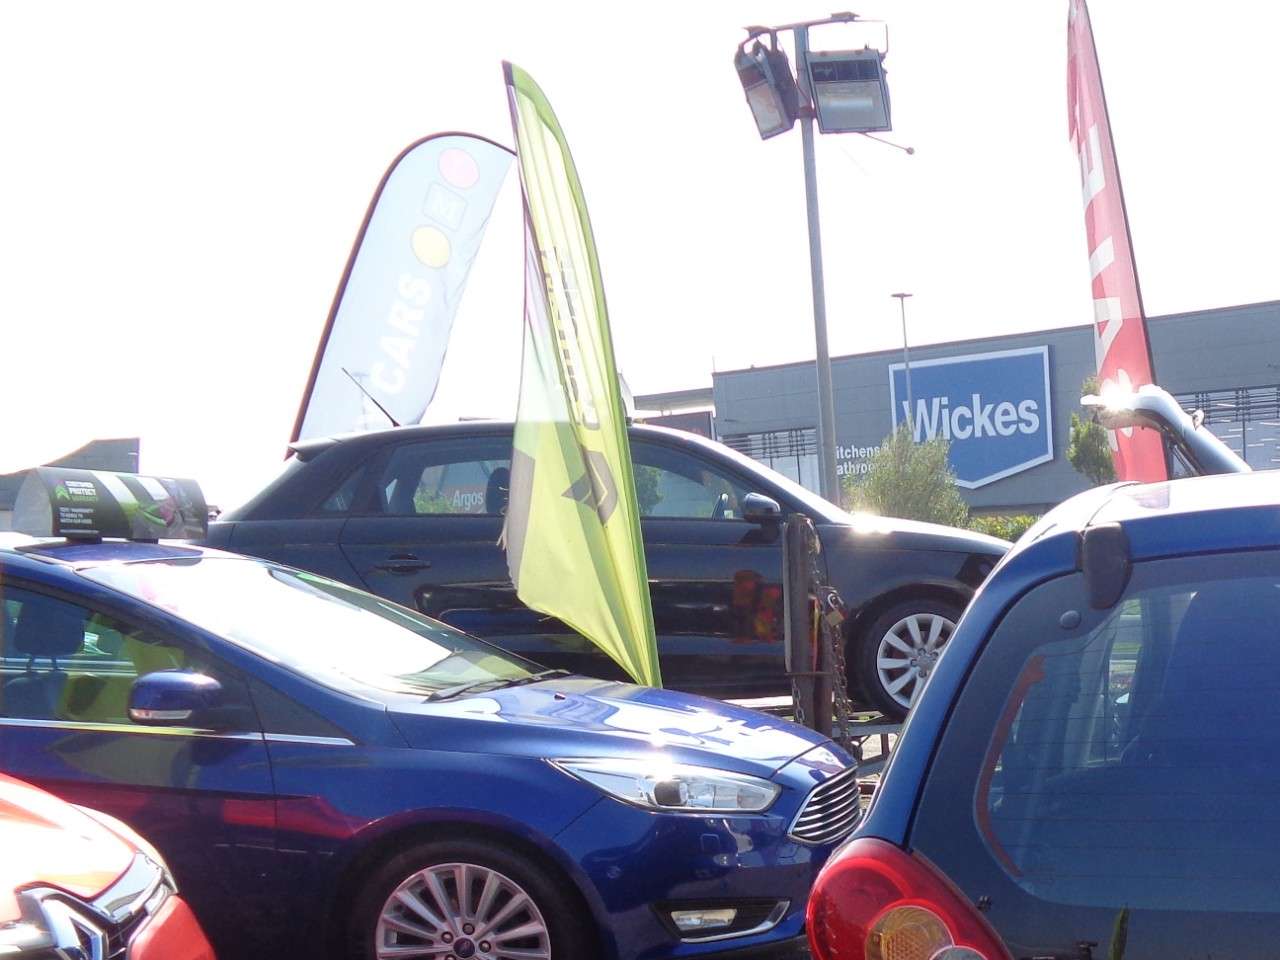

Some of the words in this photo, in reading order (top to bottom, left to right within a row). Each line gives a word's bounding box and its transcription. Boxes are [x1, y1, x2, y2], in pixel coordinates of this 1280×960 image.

[370, 272, 432, 395] CARS
[902, 393, 1040, 443] Wickes
[836, 444, 881, 459] itchens
[452, 490, 484, 511] Argos
